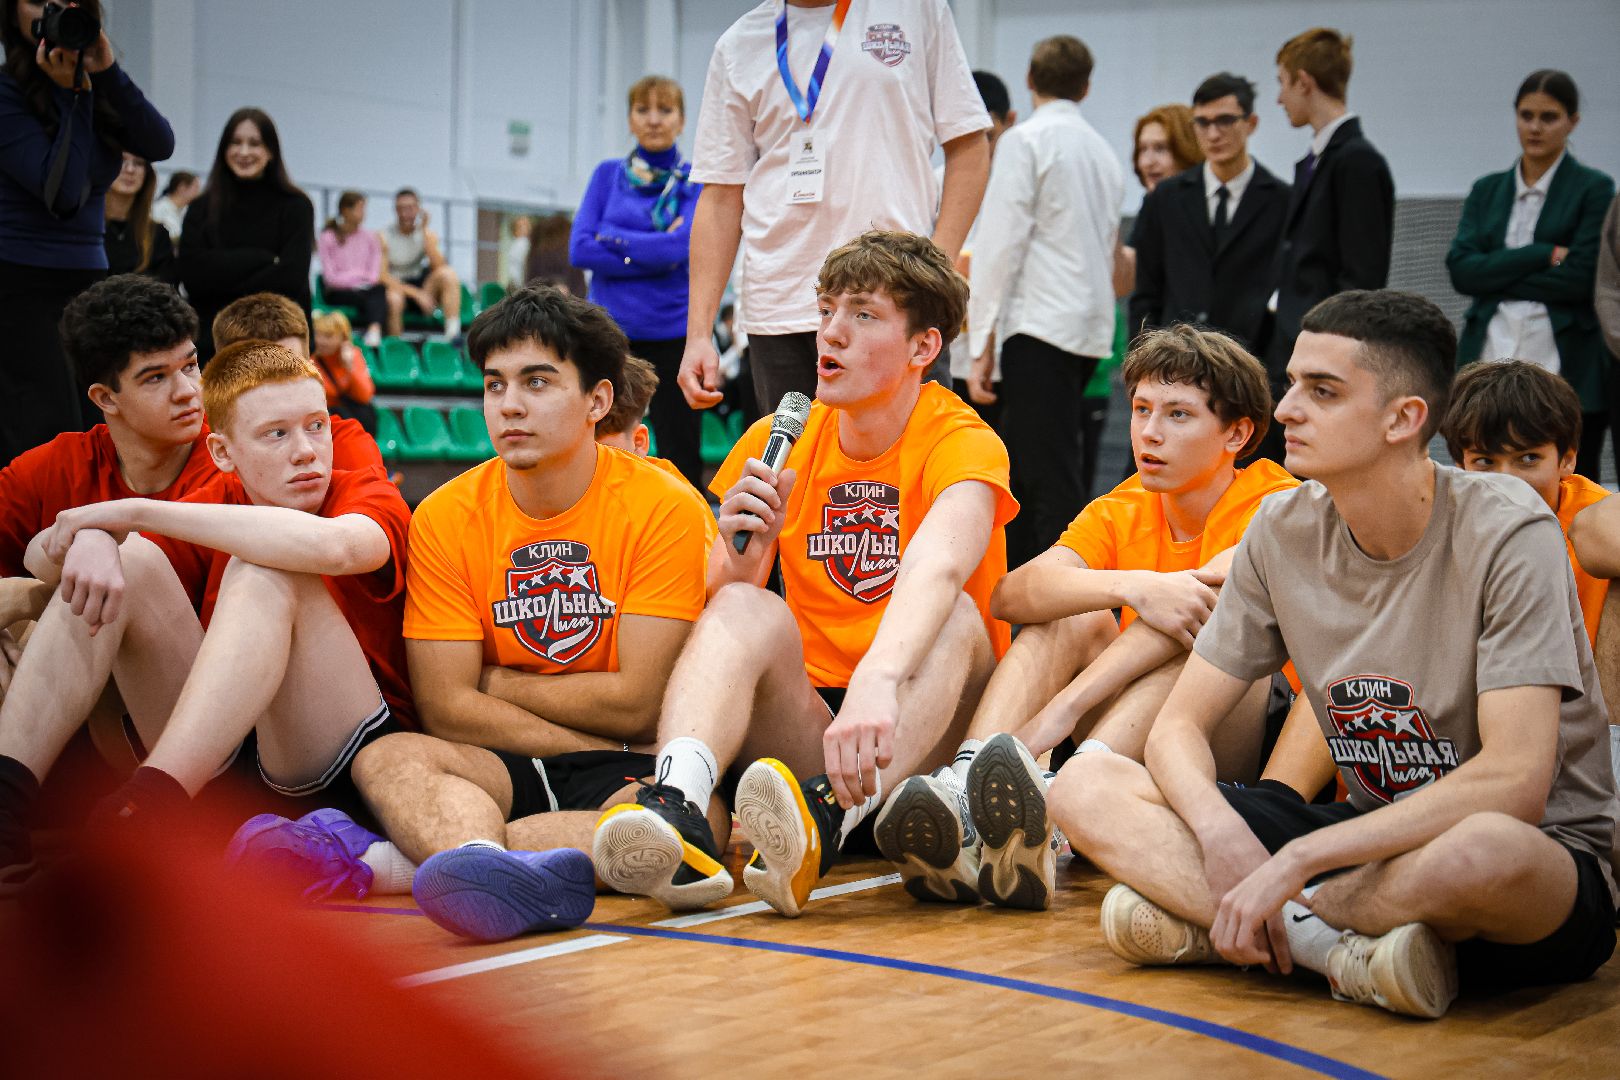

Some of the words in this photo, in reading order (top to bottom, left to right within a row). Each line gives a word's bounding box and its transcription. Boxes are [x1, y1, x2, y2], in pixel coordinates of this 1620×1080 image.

[844, 484, 885, 498] КЛИН
[528, 543, 573, 559] КЛИН
[808, 528, 899, 557] ШКОЛЬН
[540, 588, 594, 639] Лига
[1345, 681, 1392, 698] КЛИН
[1329, 735, 1458, 767] ШКОЛЬНАЯ
[1378, 735, 1436, 788] Лига
